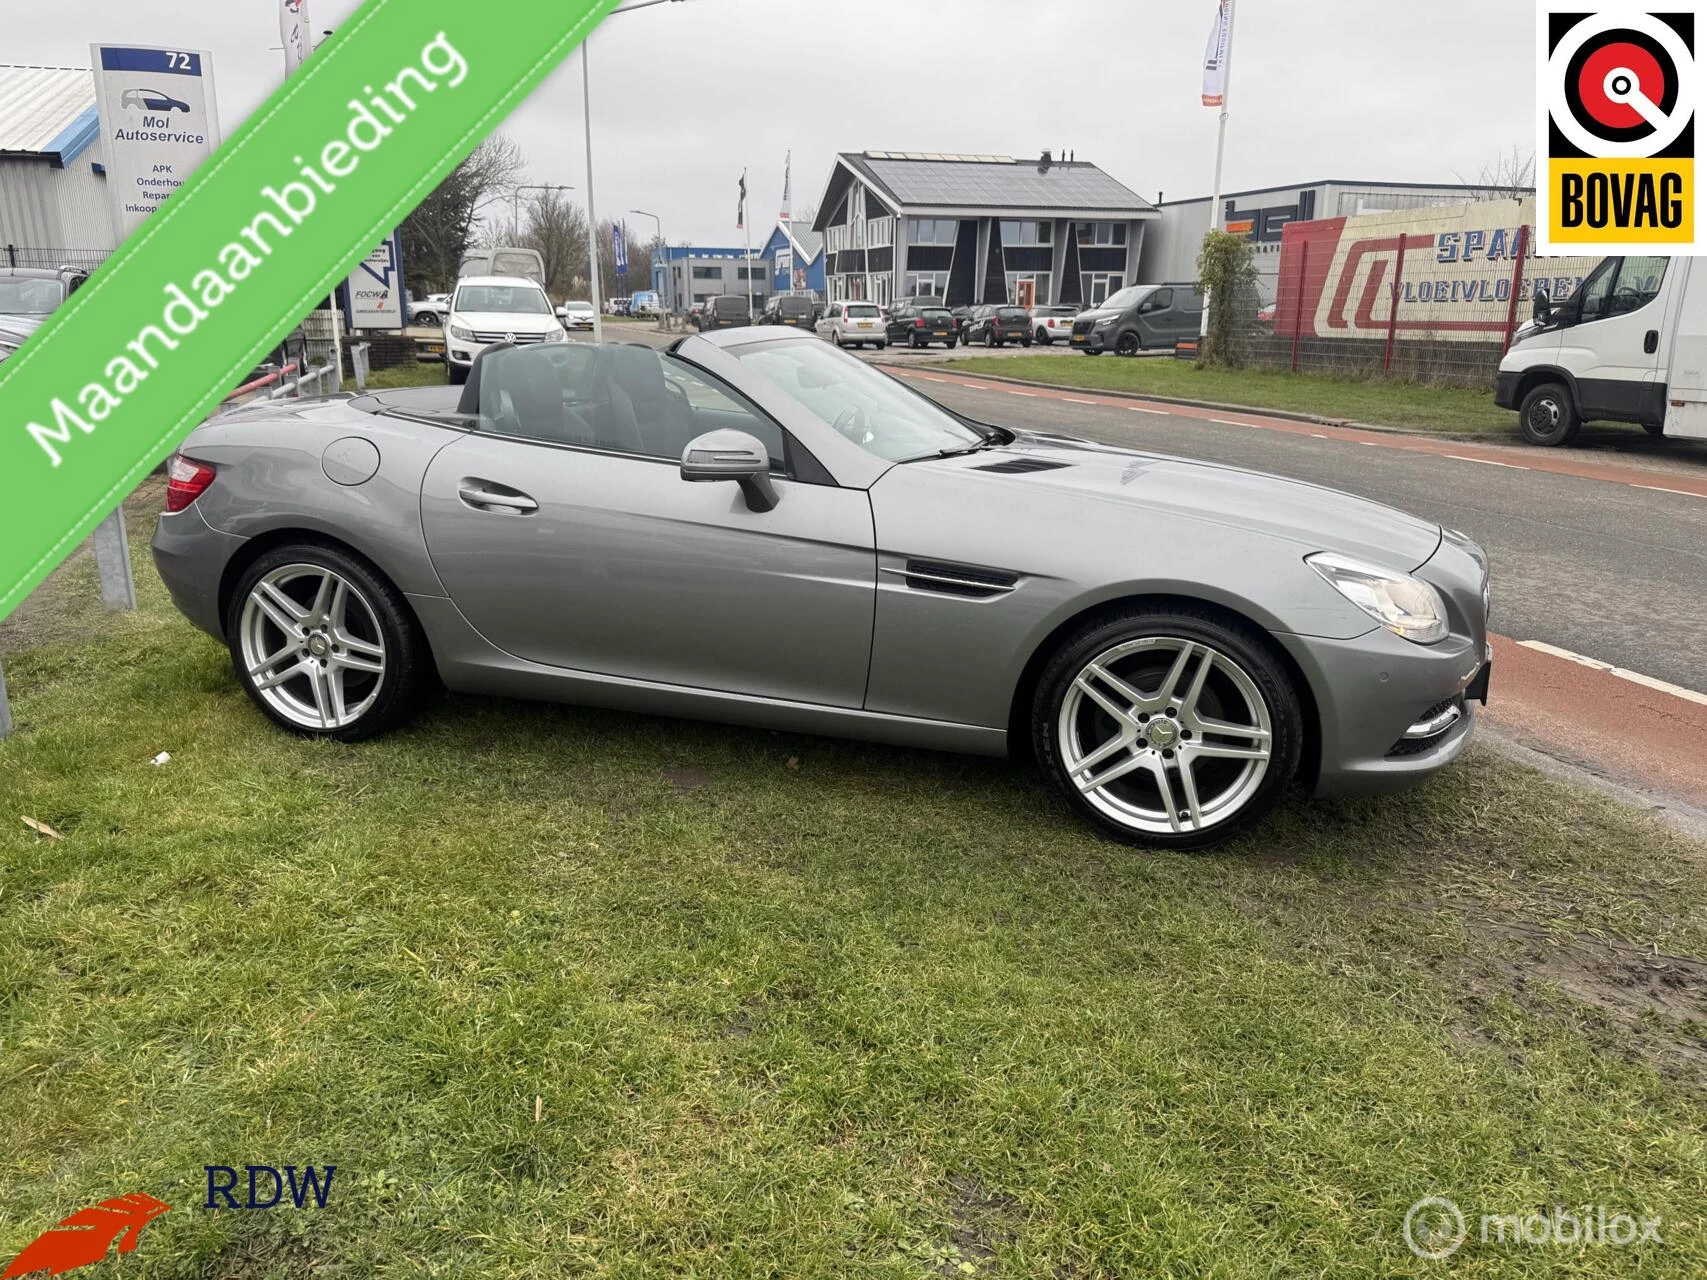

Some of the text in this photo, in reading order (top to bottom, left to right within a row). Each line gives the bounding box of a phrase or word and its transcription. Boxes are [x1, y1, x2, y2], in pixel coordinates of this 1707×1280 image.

[166, 52, 192, 70] 72
[142, 116, 170, 129] Mol
[115, 128, 204, 144] Autoservice
[152, 165, 173, 173] APK
[142, 191, 175, 201] Repar
[125, 203, 158, 214] Inkoop
[356, 289, 389, 300] FOCWA
